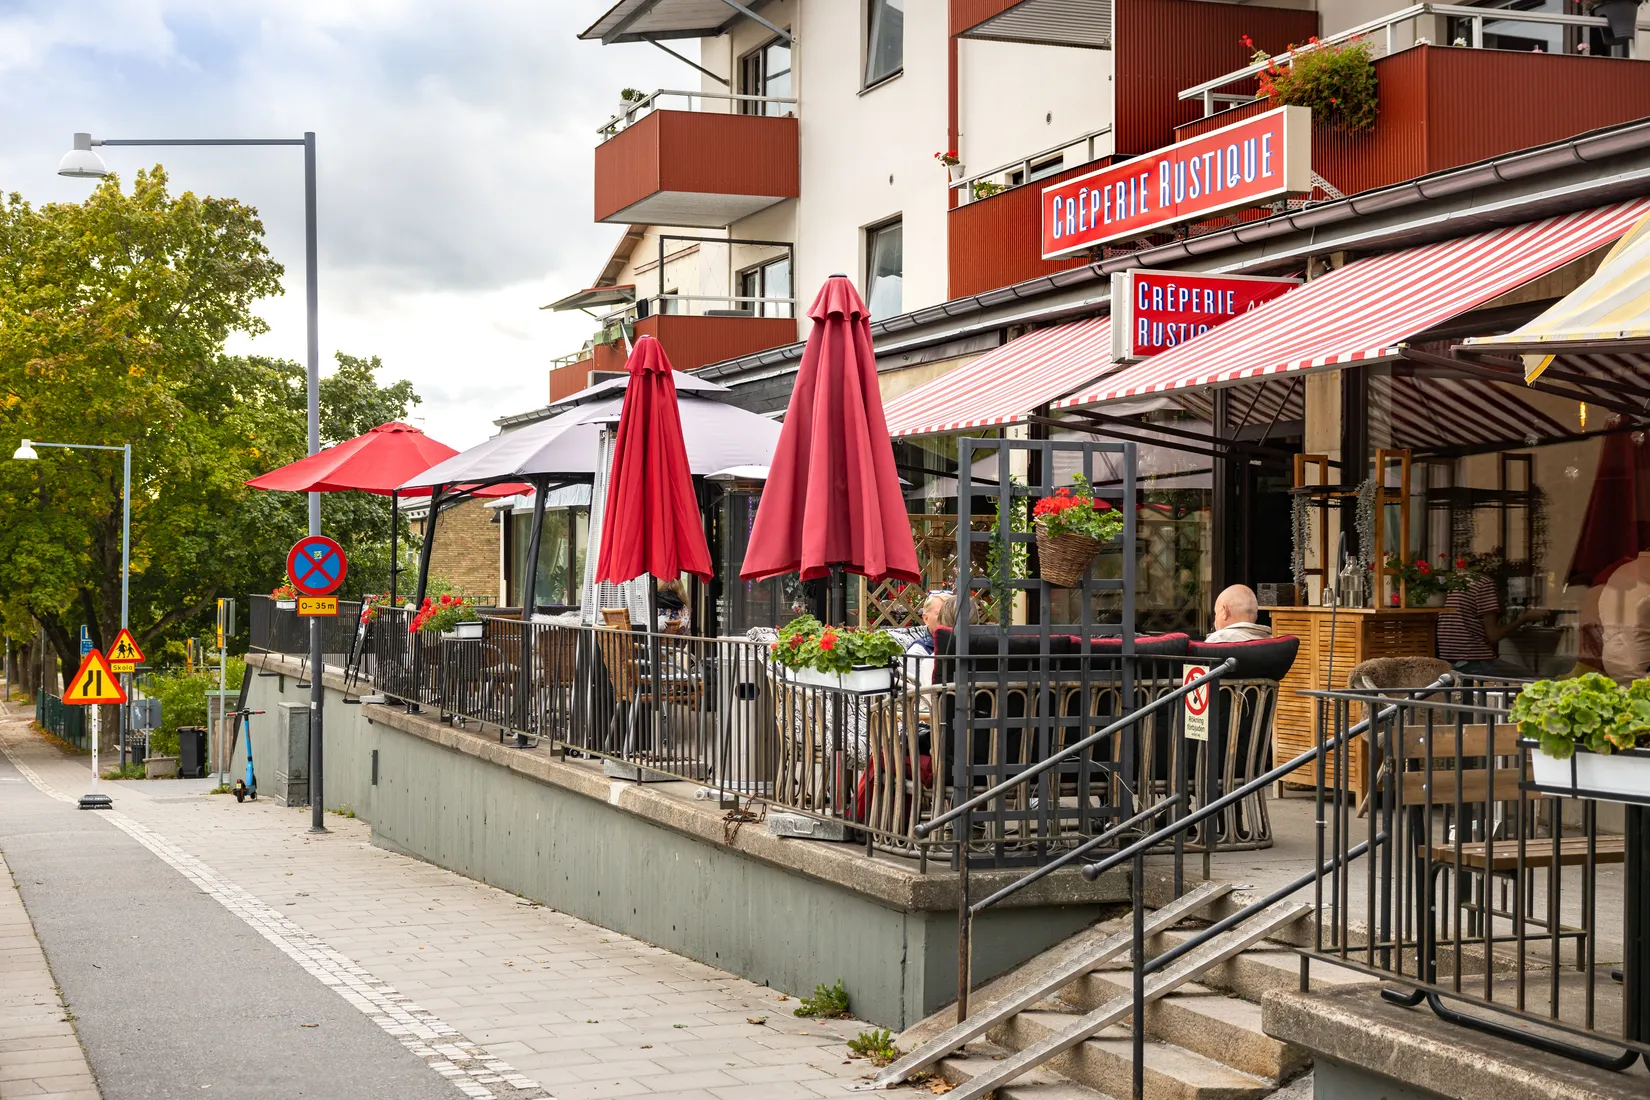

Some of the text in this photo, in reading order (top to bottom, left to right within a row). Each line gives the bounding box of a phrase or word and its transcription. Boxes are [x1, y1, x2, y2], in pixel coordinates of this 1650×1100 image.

[1053, 132, 1275, 239] CRÊPERIE RUSTIQUE
[1138, 281, 1236, 315] CRÊPERIE
